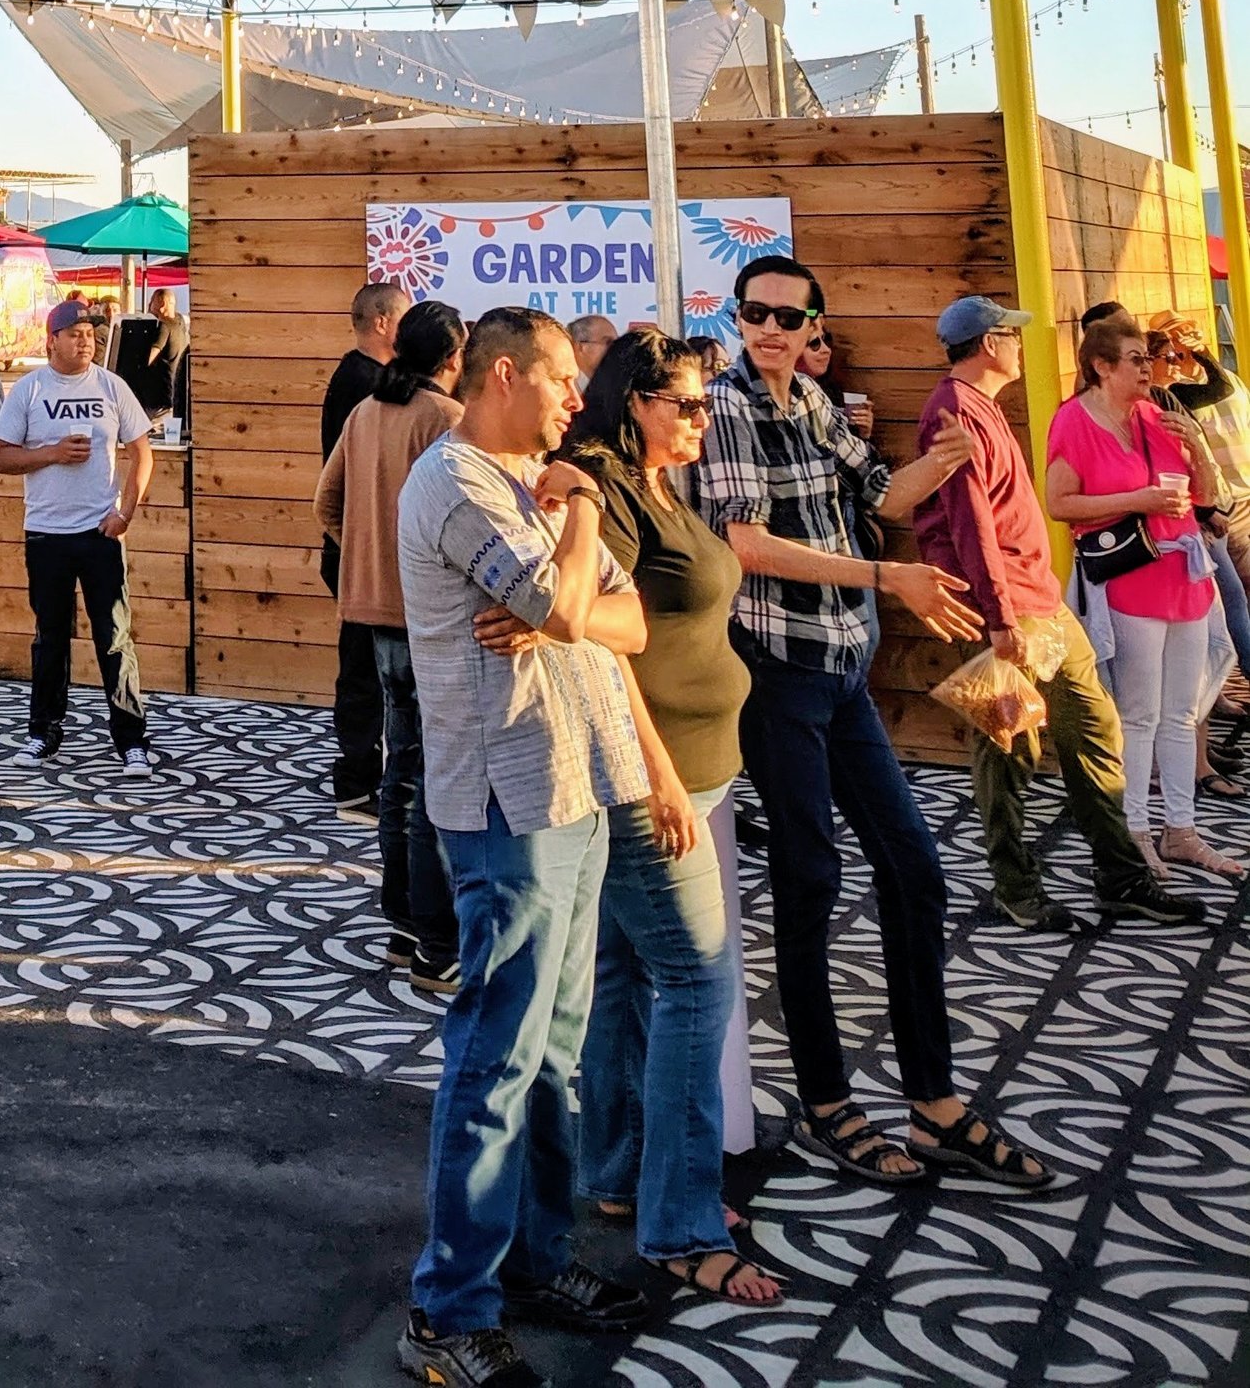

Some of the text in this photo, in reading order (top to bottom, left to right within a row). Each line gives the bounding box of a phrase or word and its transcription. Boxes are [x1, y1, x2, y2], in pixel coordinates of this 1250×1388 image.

[472, 242, 655, 284] GARDEN
[527, 291, 617, 315] AT THE
[43, 397, 105, 420] VANS
